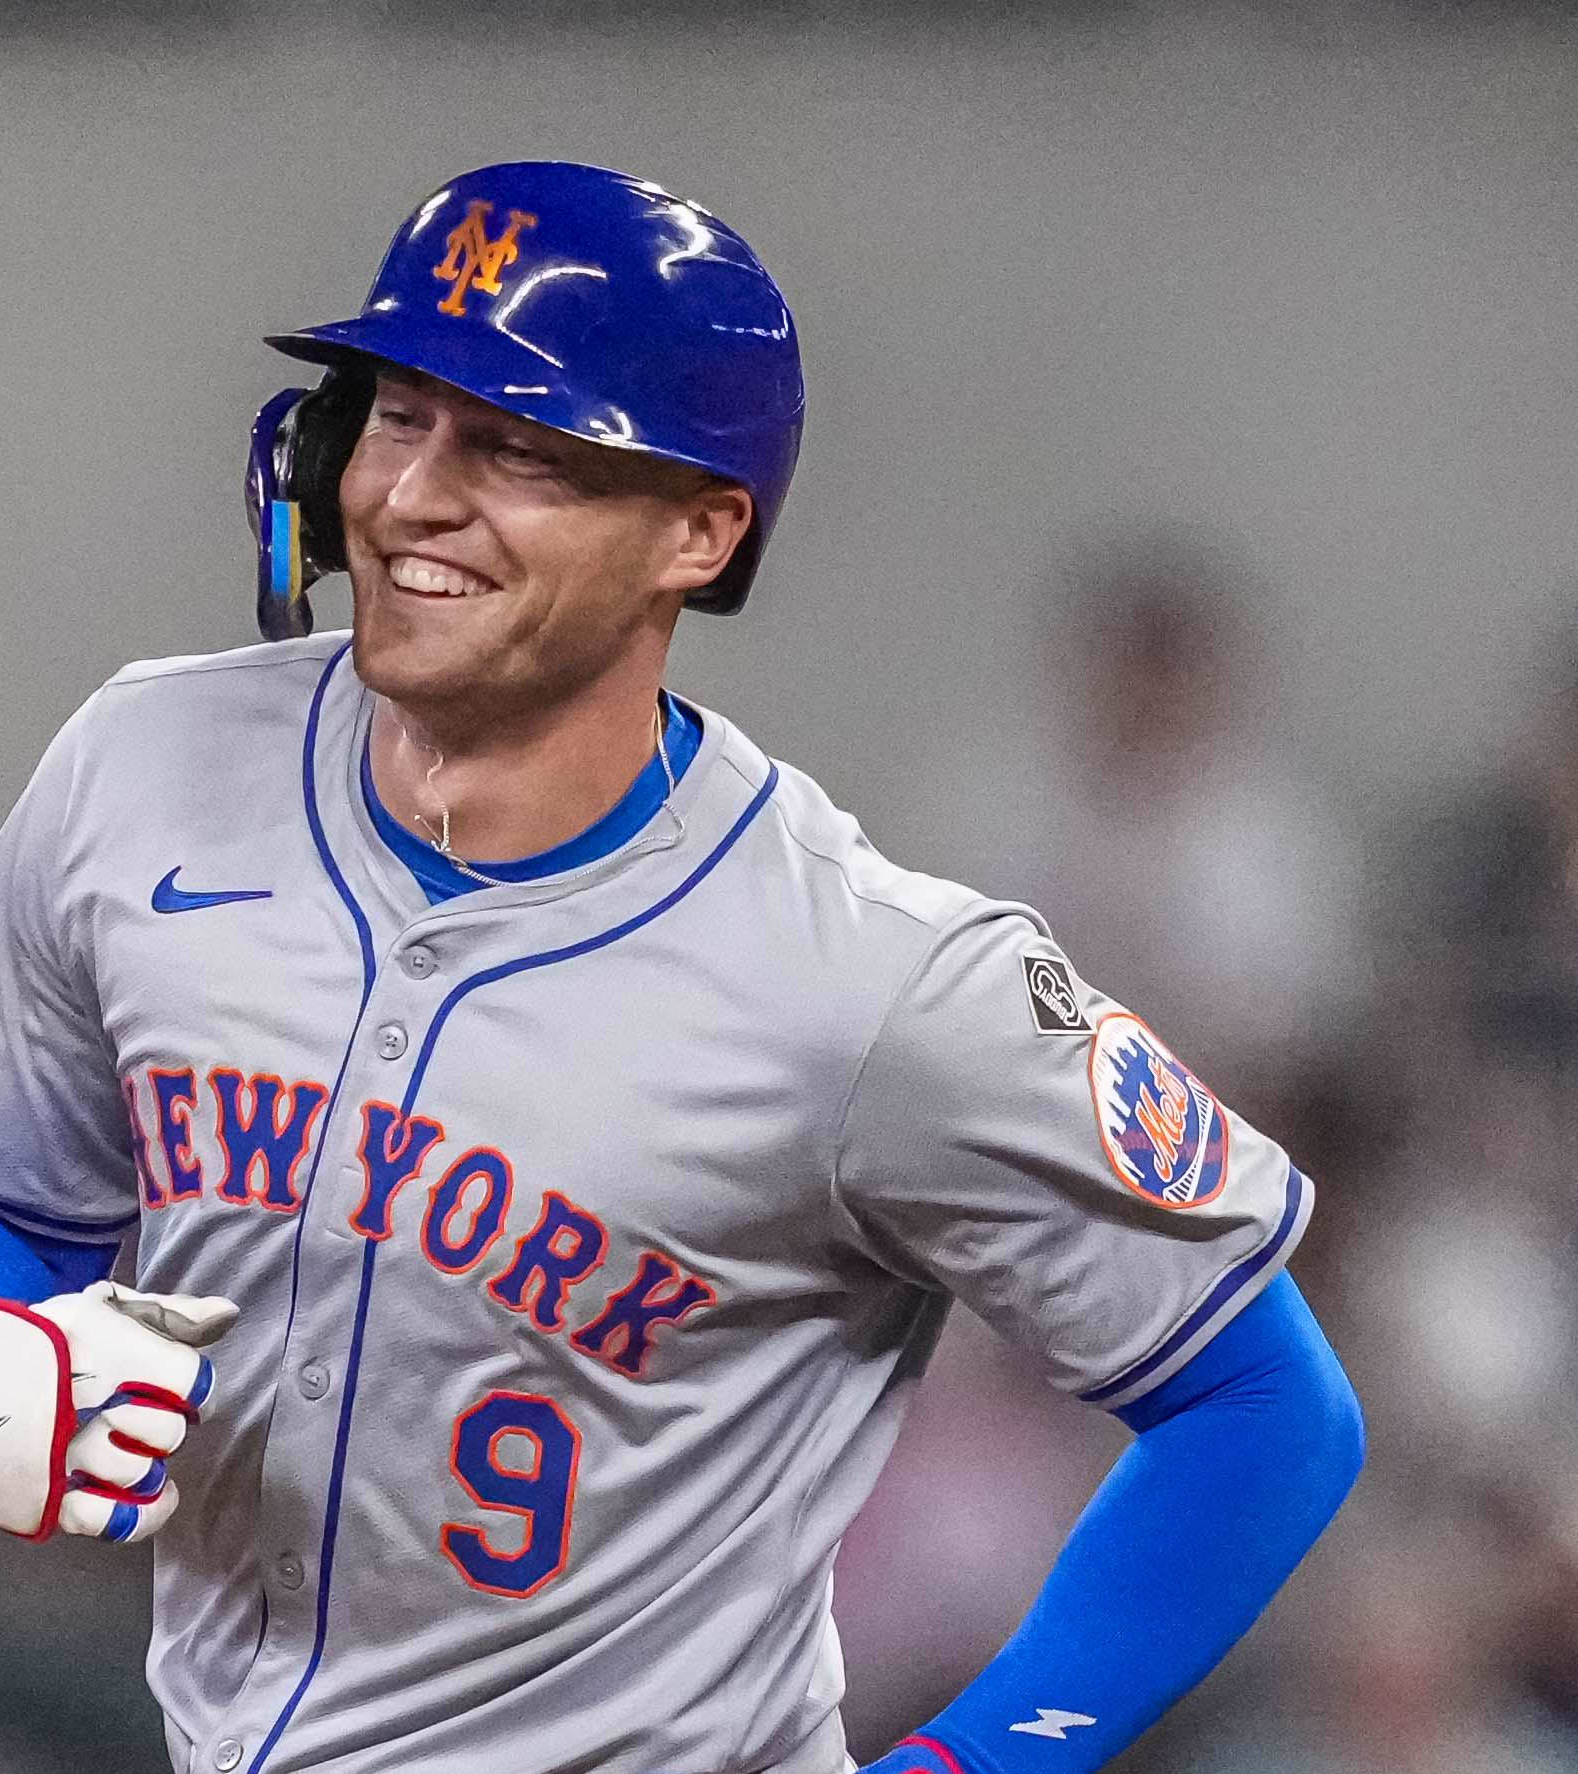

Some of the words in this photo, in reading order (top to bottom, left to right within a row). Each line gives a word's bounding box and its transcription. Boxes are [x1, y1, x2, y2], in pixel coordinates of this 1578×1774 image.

[433, 199, 538, 317] NY
[1135, 1056, 1189, 1183] Mets
[348, 1100, 716, 1379] YORK
[440, 1388, 584, 1599] 9
